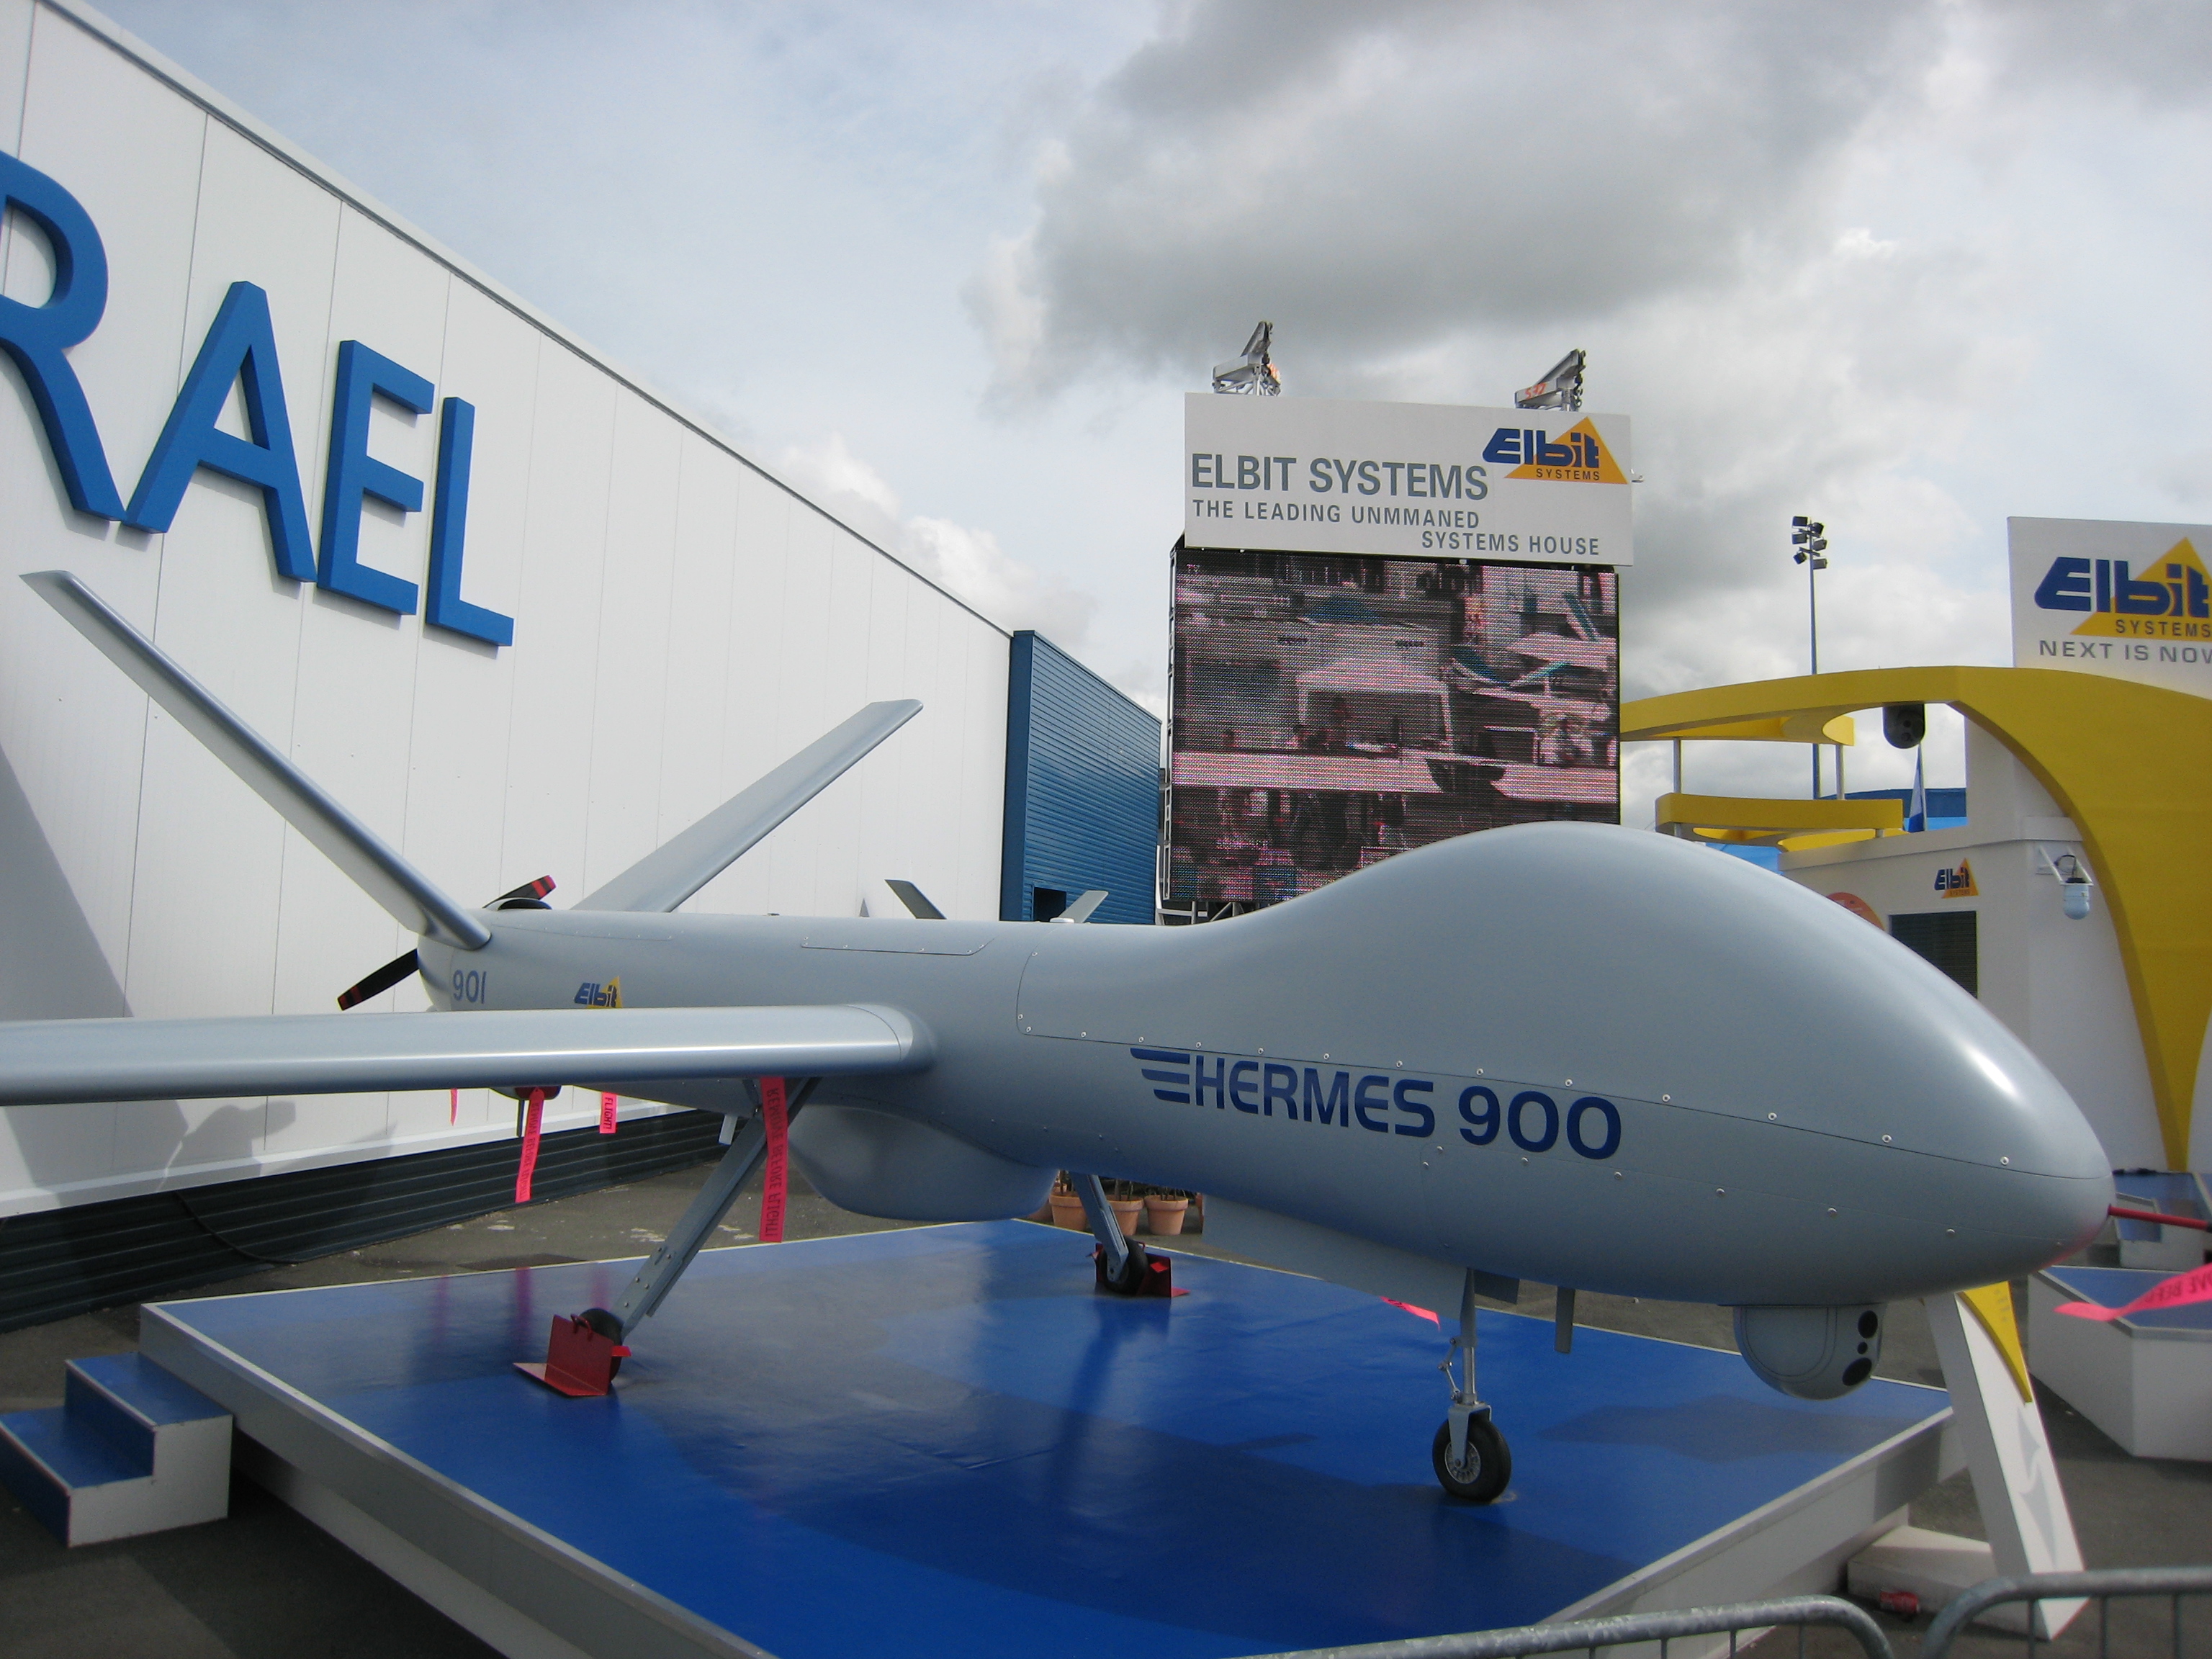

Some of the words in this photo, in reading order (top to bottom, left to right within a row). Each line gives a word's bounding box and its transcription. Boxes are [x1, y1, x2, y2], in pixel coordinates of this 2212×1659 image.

[1482, 428, 1599, 468] Elbit
[1192, 453, 1297, 491] ELBIT
[1309, 457, 1488, 500] SYSTEMS
[1536, 468, 1600, 480] SYSTEMS
[1192, 499, 1233, 518] THE
[1244, 501, 1340, 523] LEADING
[1352, 505, 1479, 529] UNMMANED
[1421, 530, 1519, 552] SYSTEMS
[1529, 535, 1599, 555] HOUSE
[2034, 557, 2210, 618] Elbit
[2116, 619, 2211, 638] SYSTEMS
[2039, 640, 2113, 659] NEXT
[2125, 644, 2149, 661] IS
[1934, 868, 1969, 891] Elbit
[453, 970, 487, 1004] 901
[574, 982, 617, 1008] Elbit
[1196, 1055, 1435, 1138] HERMES
[1458, 1086, 1622, 1160] 900
